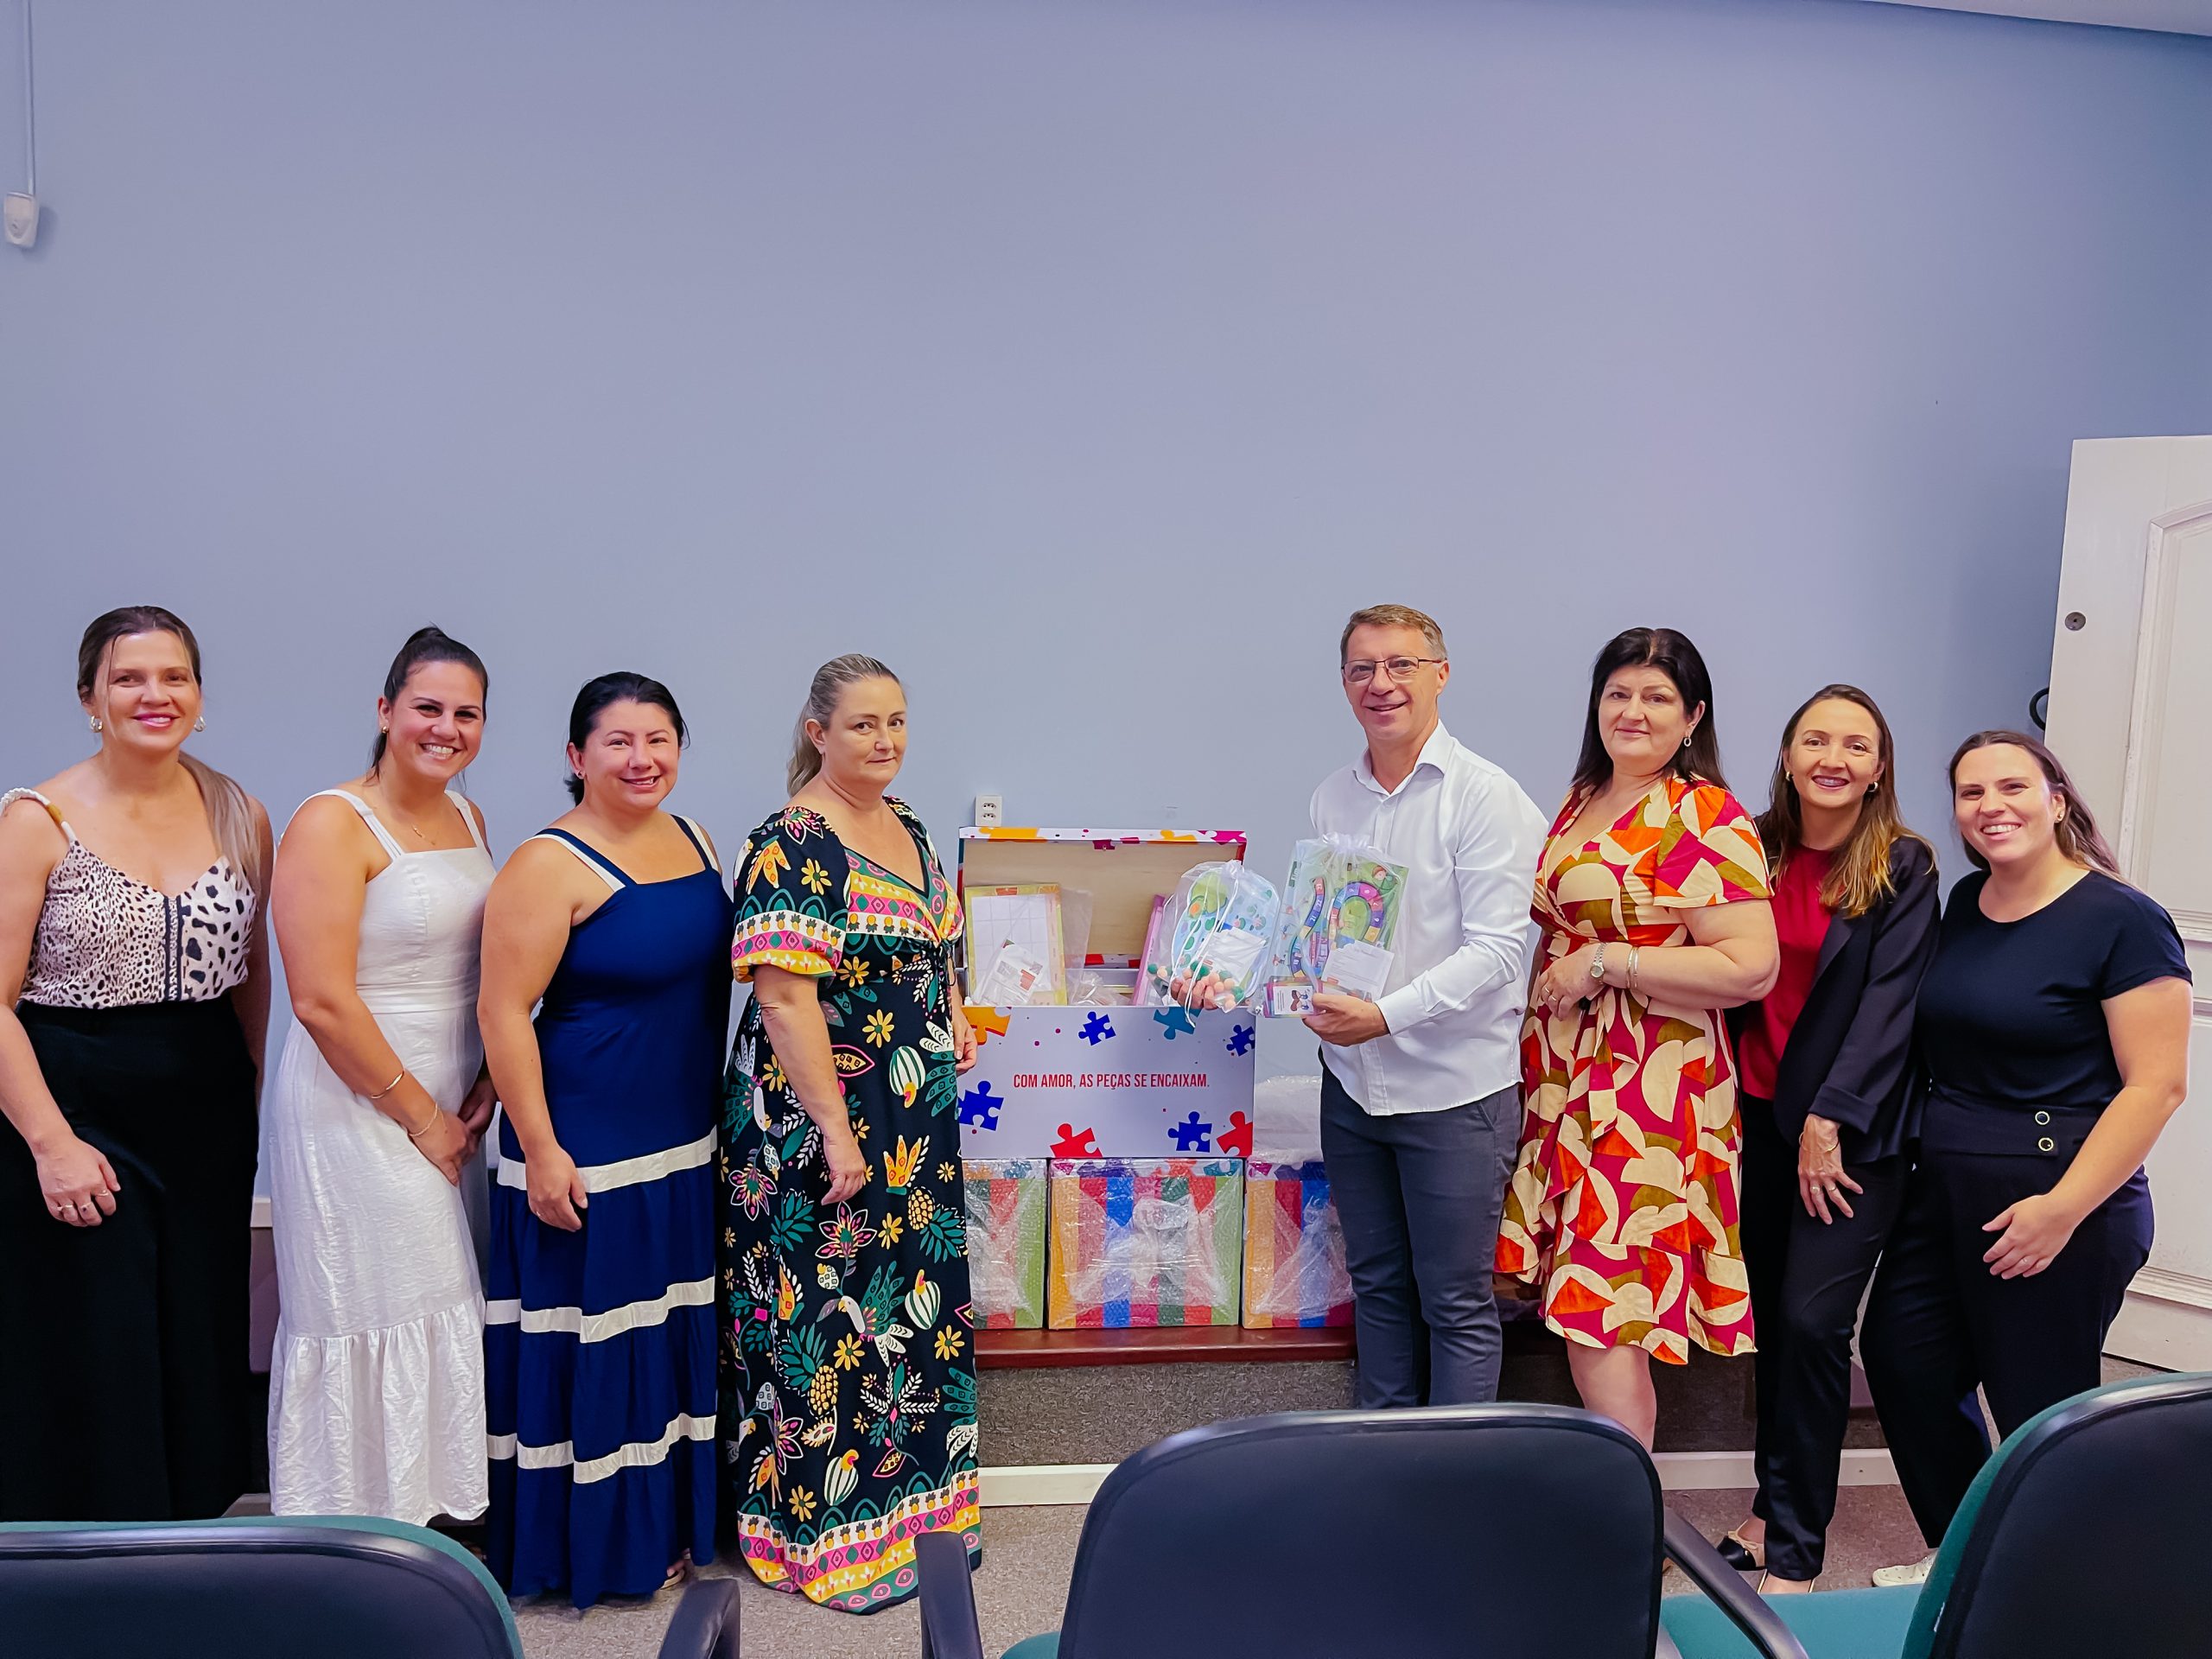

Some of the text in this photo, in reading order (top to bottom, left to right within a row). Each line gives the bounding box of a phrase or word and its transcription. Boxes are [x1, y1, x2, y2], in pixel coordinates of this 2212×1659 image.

[1014, 1074, 1210, 1090] COM AMOR, AS PEÇAS SE ENCAIXAM.
